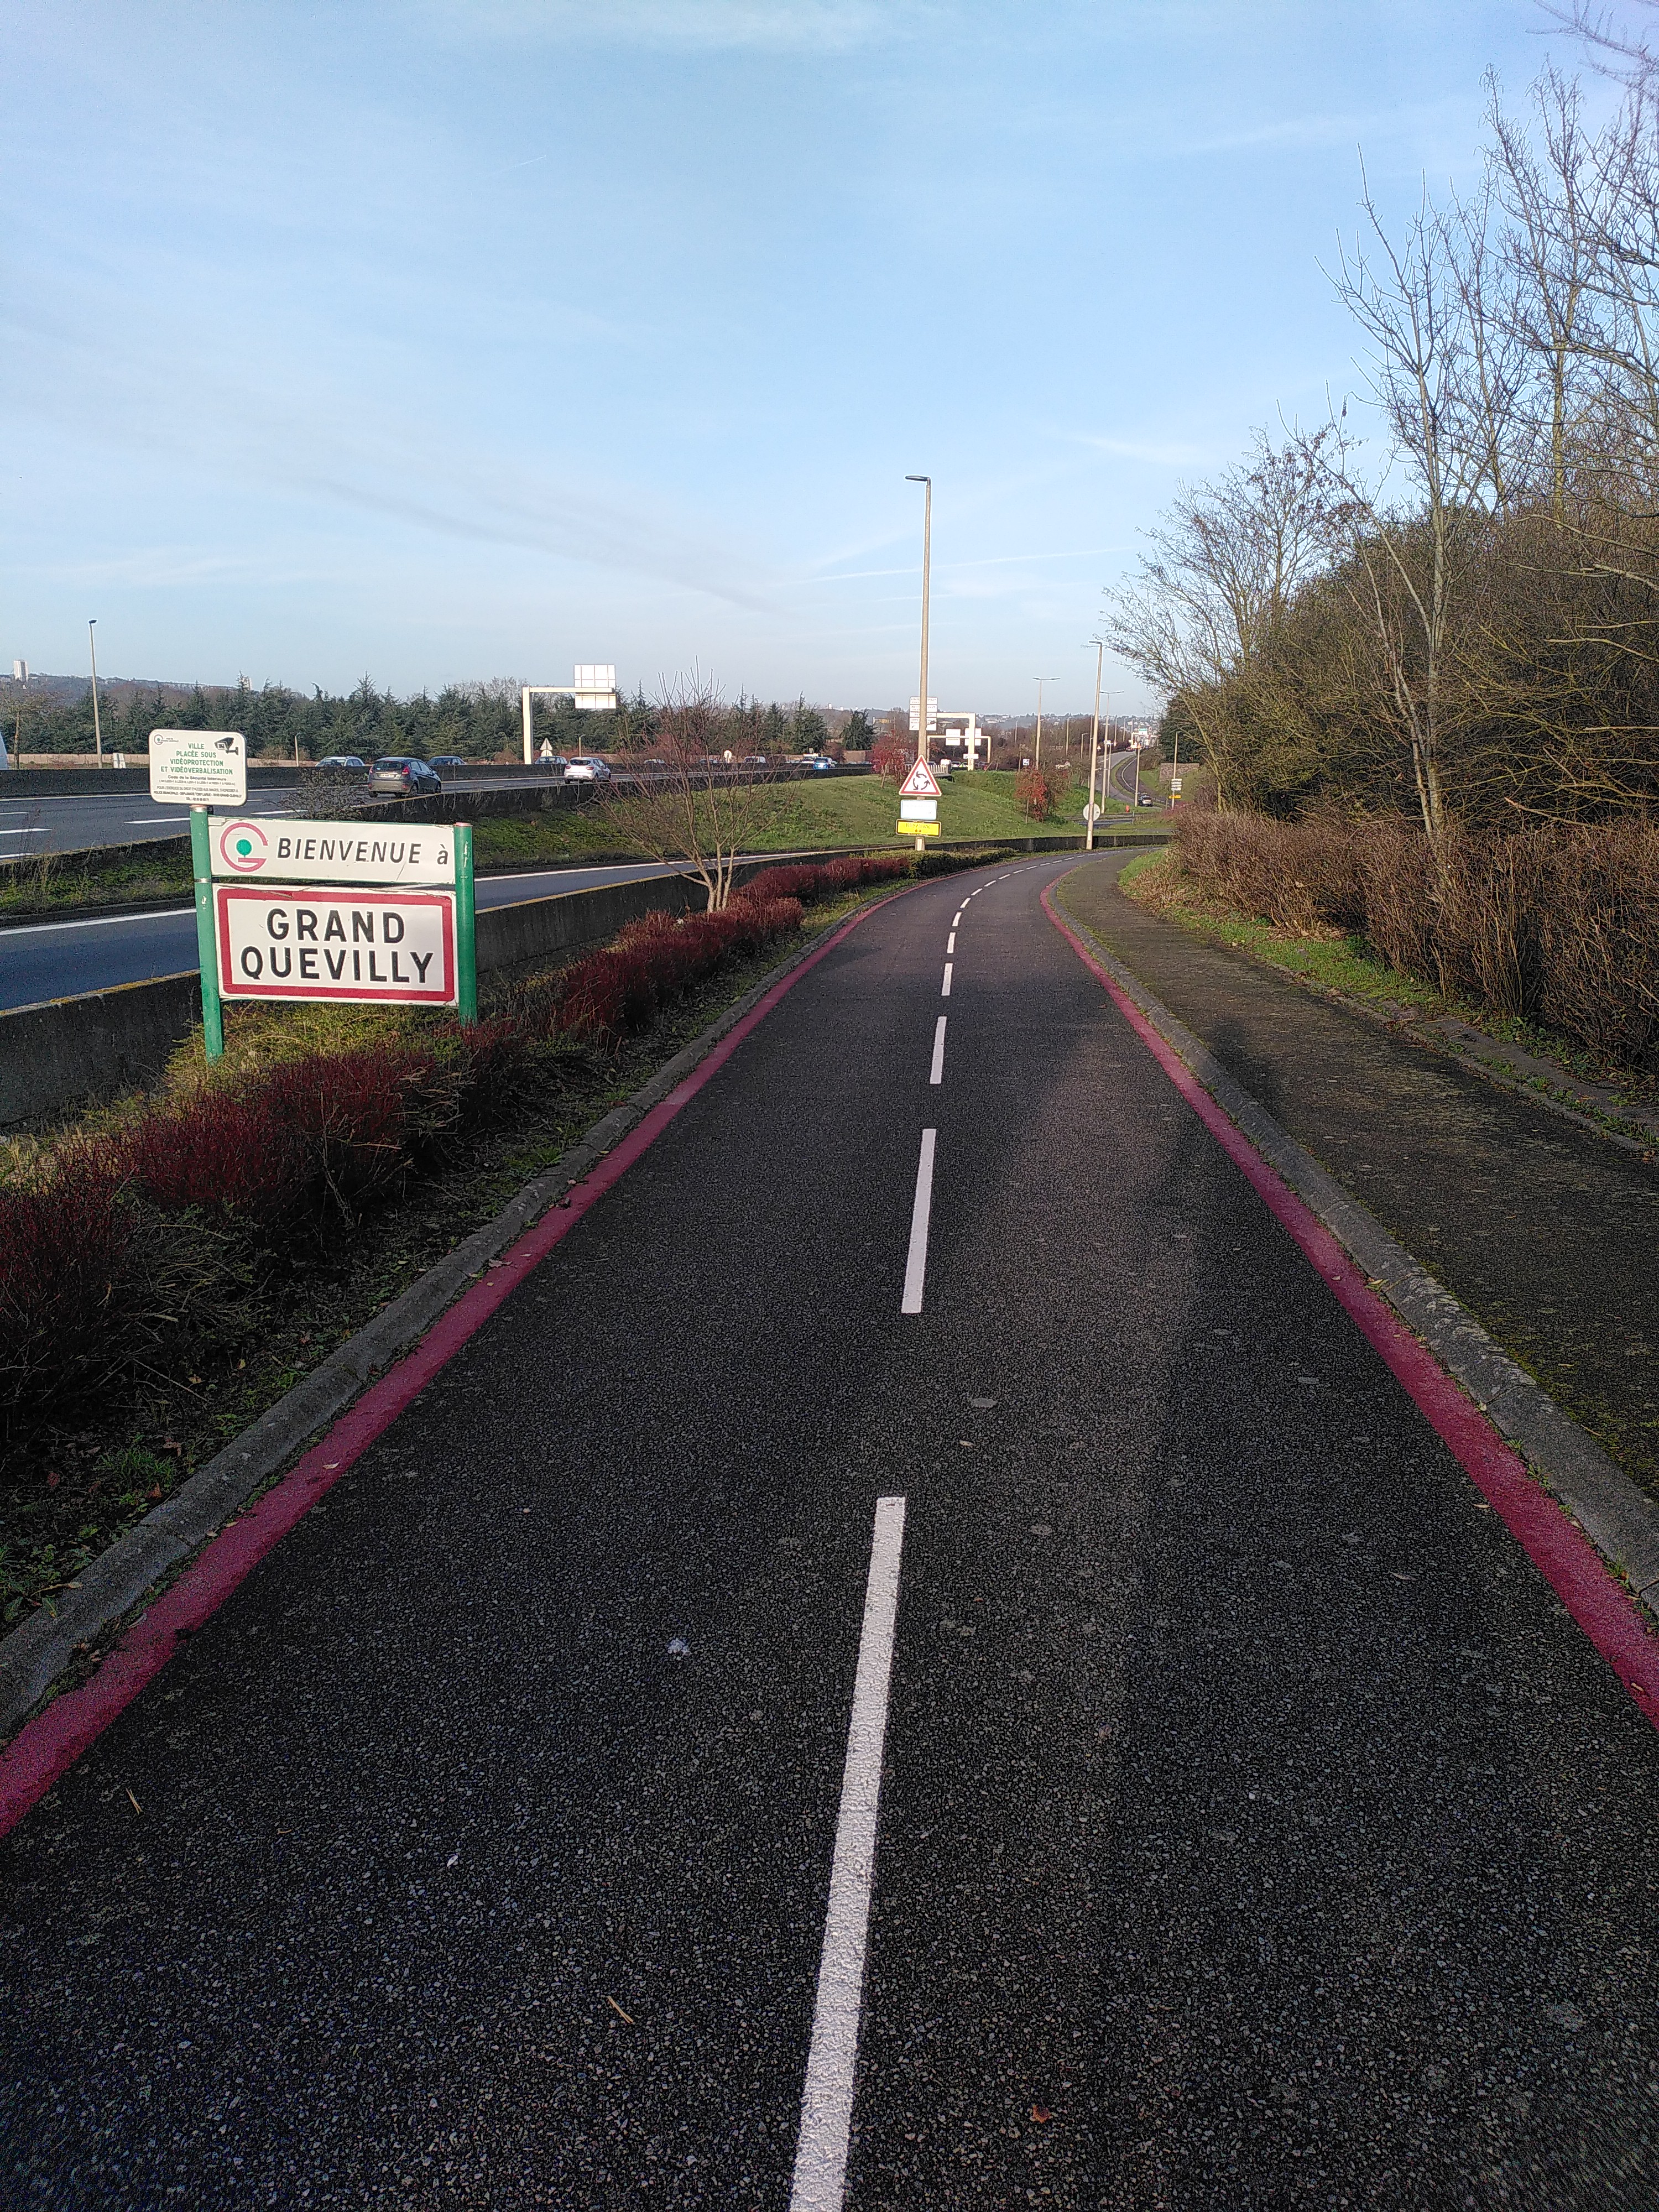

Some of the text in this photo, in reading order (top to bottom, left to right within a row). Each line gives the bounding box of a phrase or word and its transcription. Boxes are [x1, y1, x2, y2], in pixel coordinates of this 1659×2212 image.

[169, 758, 223, 766] VIDÉOPROTECTION
[170, 766, 233, 775] VIDÉOVERBALISATION
[276, 837, 449, 865] BIENVENUE à
[267, 908, 405, 944] GRAND
[241, 946, 434, 983] QUEVILLY
